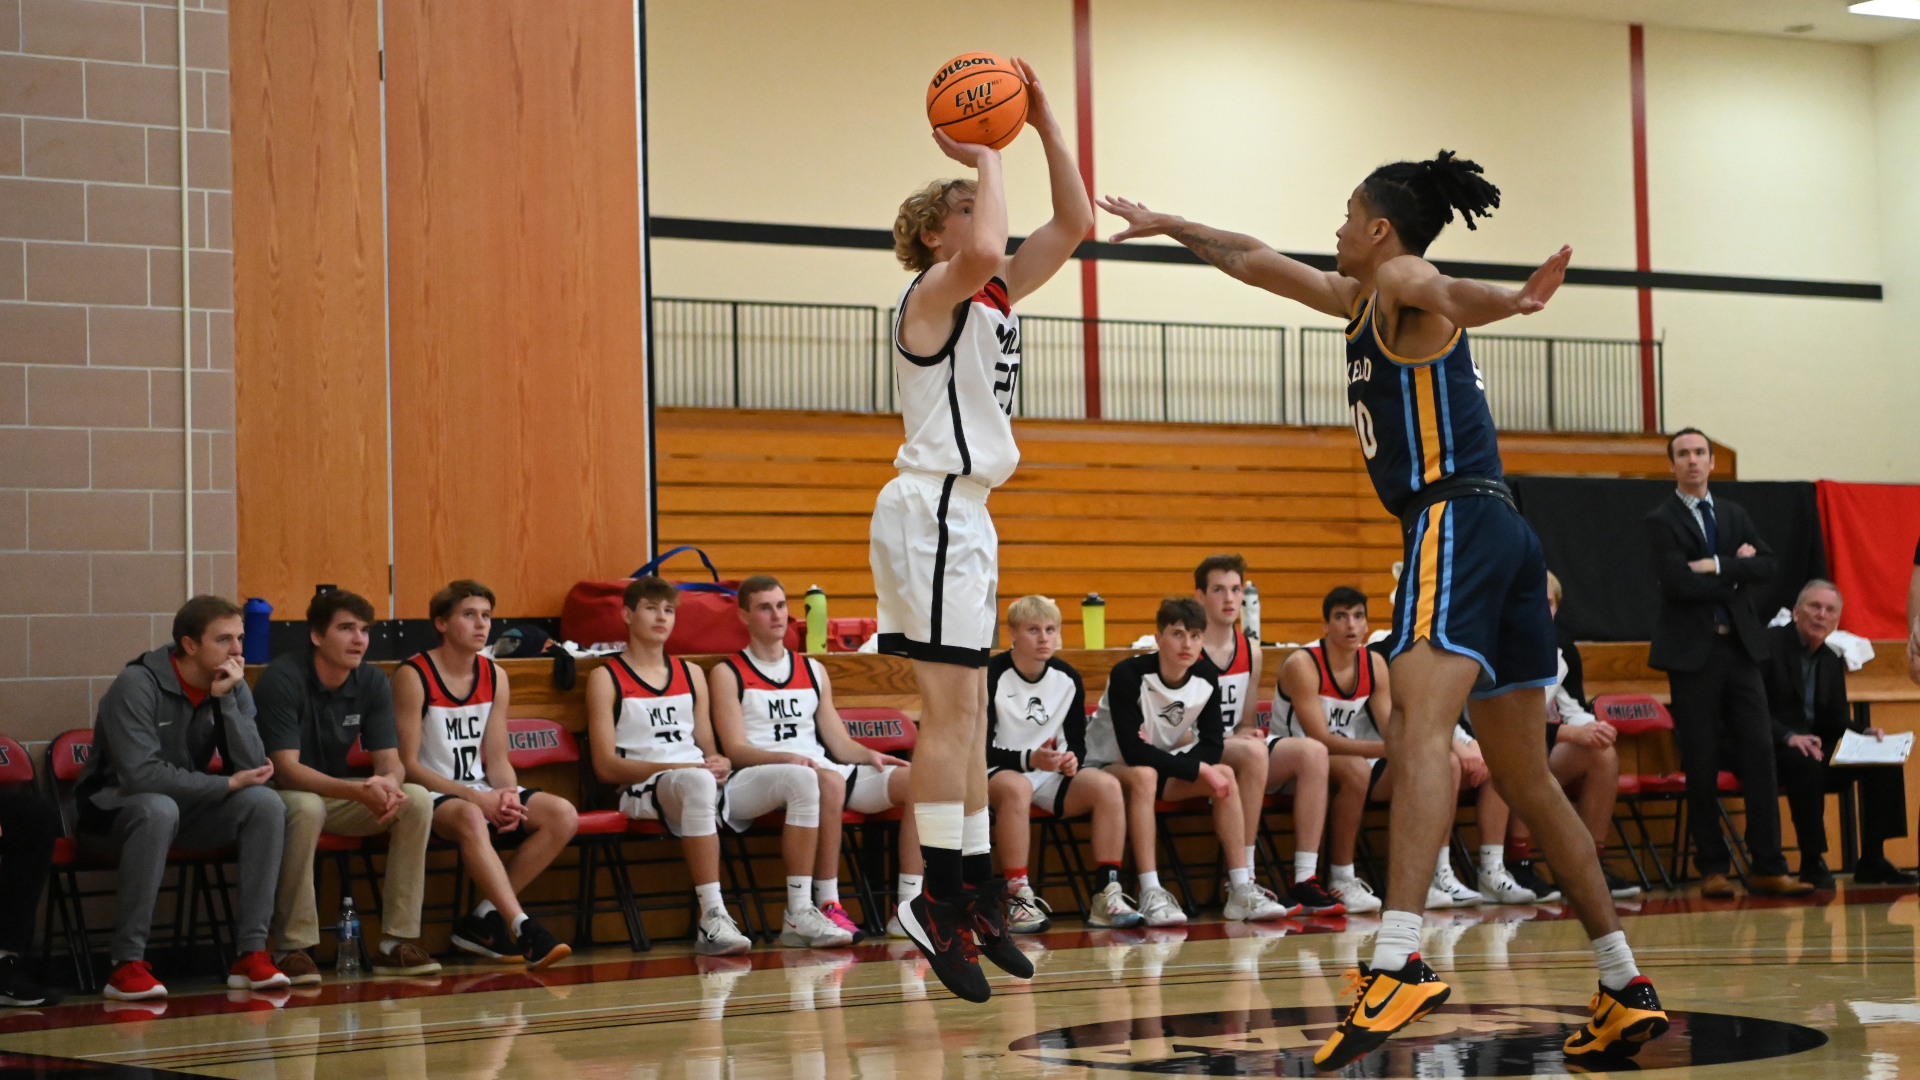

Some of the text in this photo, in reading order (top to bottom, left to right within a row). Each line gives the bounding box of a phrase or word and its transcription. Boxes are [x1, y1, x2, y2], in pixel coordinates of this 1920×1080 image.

[932, 57, 996, 88] Wilson
[955, 82, 992, 108] EVO
[962, 96, 993, 116] MLC
[1218, 684, 1237, 705] LC
[646, 706, 679, 727] MLC
[767, 698, 802, 719] MLC
[1604, 702, 1659, 721] KNIGHTS
[445, 716, 481, 740] MLC
[843, 718, 904, 738] NIGHTS
[508, 729, 560, 751] IGHTS
[453, 745, 477, 781] 10
